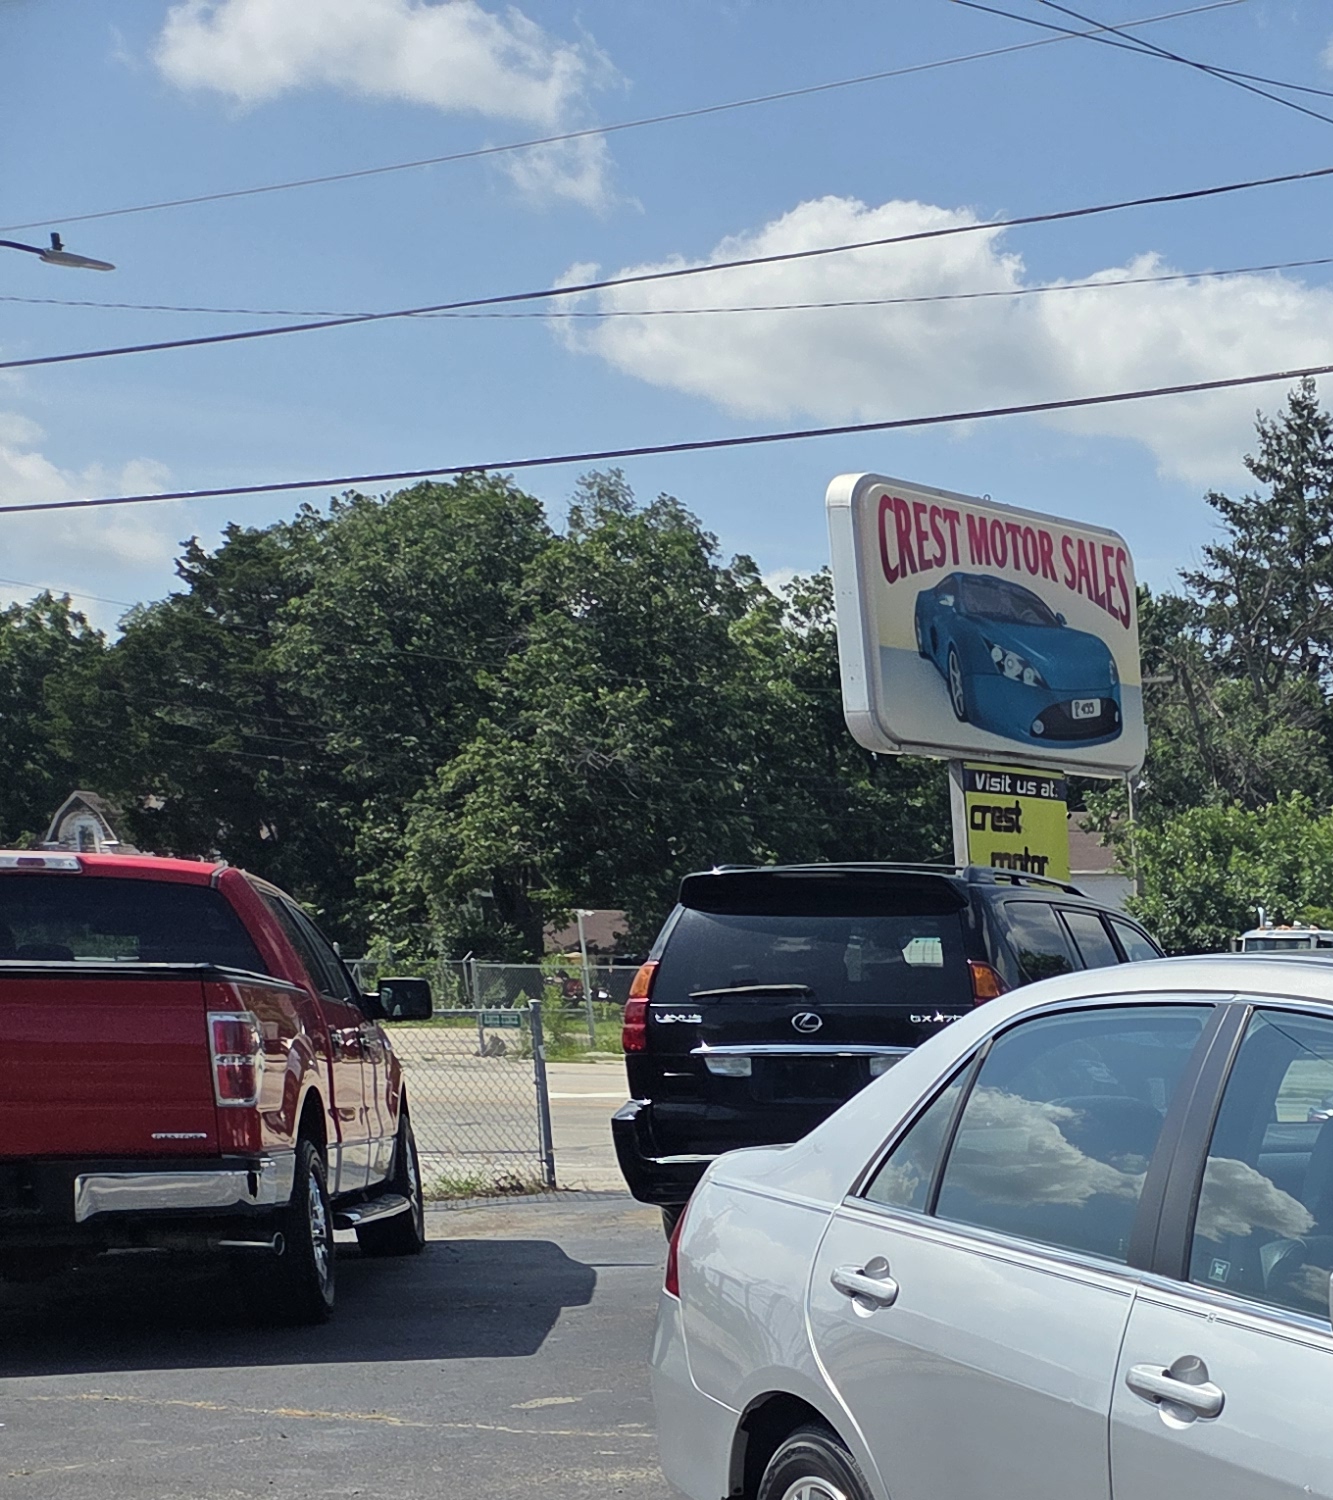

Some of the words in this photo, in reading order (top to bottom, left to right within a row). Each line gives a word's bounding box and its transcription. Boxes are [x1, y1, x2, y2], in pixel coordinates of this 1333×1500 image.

[878, 494, 961, 585] CREST
[966, 513, 1058, 583] MOTOR
[1062, 534, 1131, 630] SALES
[975, 772, 1012, 793] Visit
[1016, 779, 1037, 795] us
[970, 799, 1022, 834] crest
[655, 1013, 702, 1023] LEXUS
